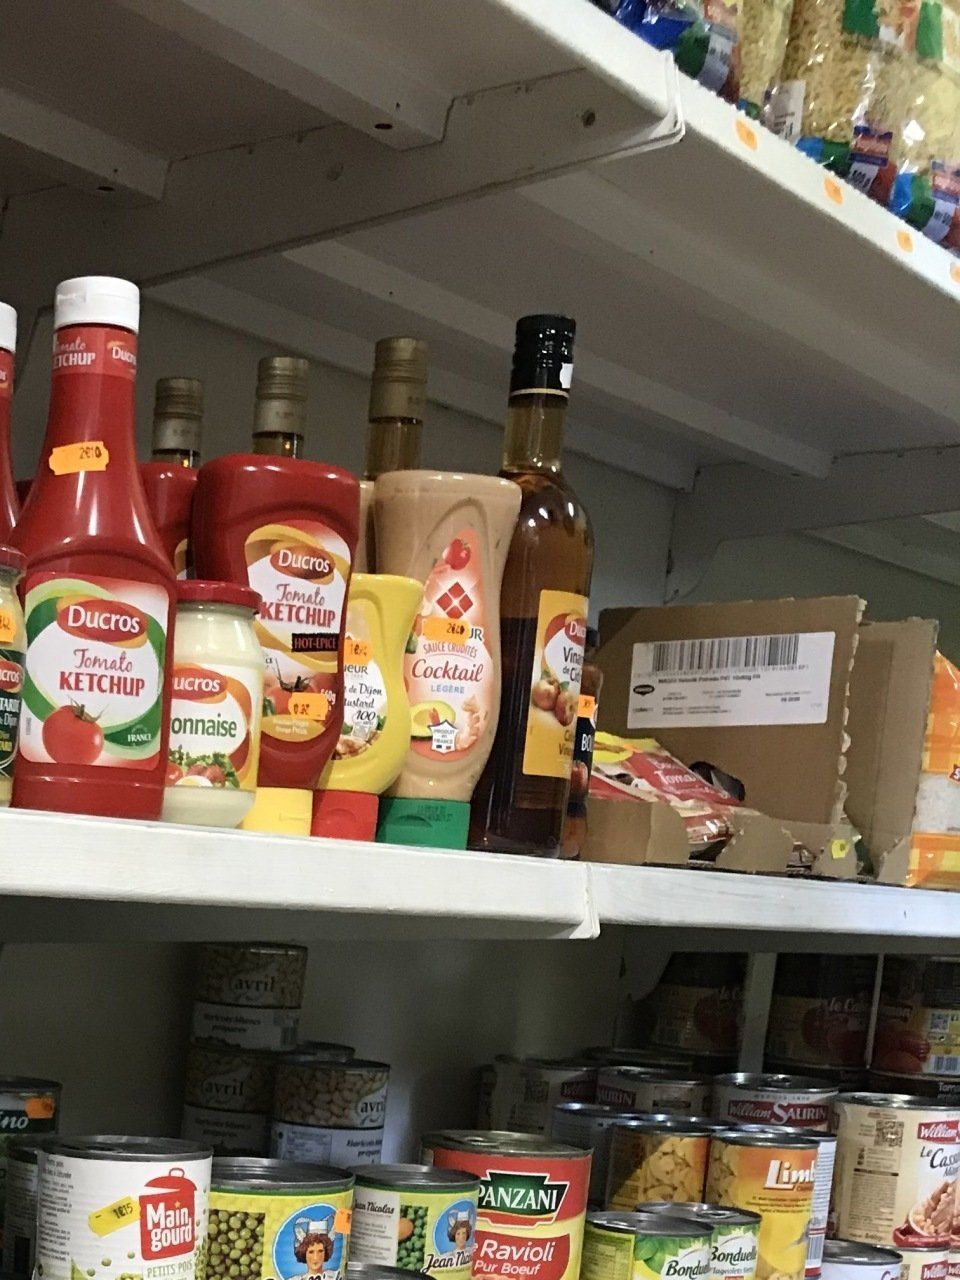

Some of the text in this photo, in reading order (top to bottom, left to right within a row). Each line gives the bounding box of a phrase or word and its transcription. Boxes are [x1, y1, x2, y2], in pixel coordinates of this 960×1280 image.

[277, 549, 331, 575] Ducros
[275, 583, 326, 607] Tomato
[67, 605, 140, 633] Ducros
[260, 601, 336, 629] KETCHUP
[73, 648, 133, 673] Tomato
[422, 642, 445, 656] SAUCE
[412, 657, 484, 683] Cocktail
[59, 671, 145, 698] KETCHUP
[172, 675, 221, 694] ucros
[359, 683, 383, 698] Dijon
[171, 712, 238, 739] onnaise
[728, 1102, 772, 1120] William
[478, 1184, 558, 1210] PANZANI
[146, 1202, 189, 1231] Main
[150, 1218, 192, 1253] gourd
[480, 1239, 556, 1262] Ravioli
[147, 1262, 176, 1278] PETITS
[421, 1253, 454, 1277] Jean
[474, 1260, 541, 1276] Pur Boeuf
